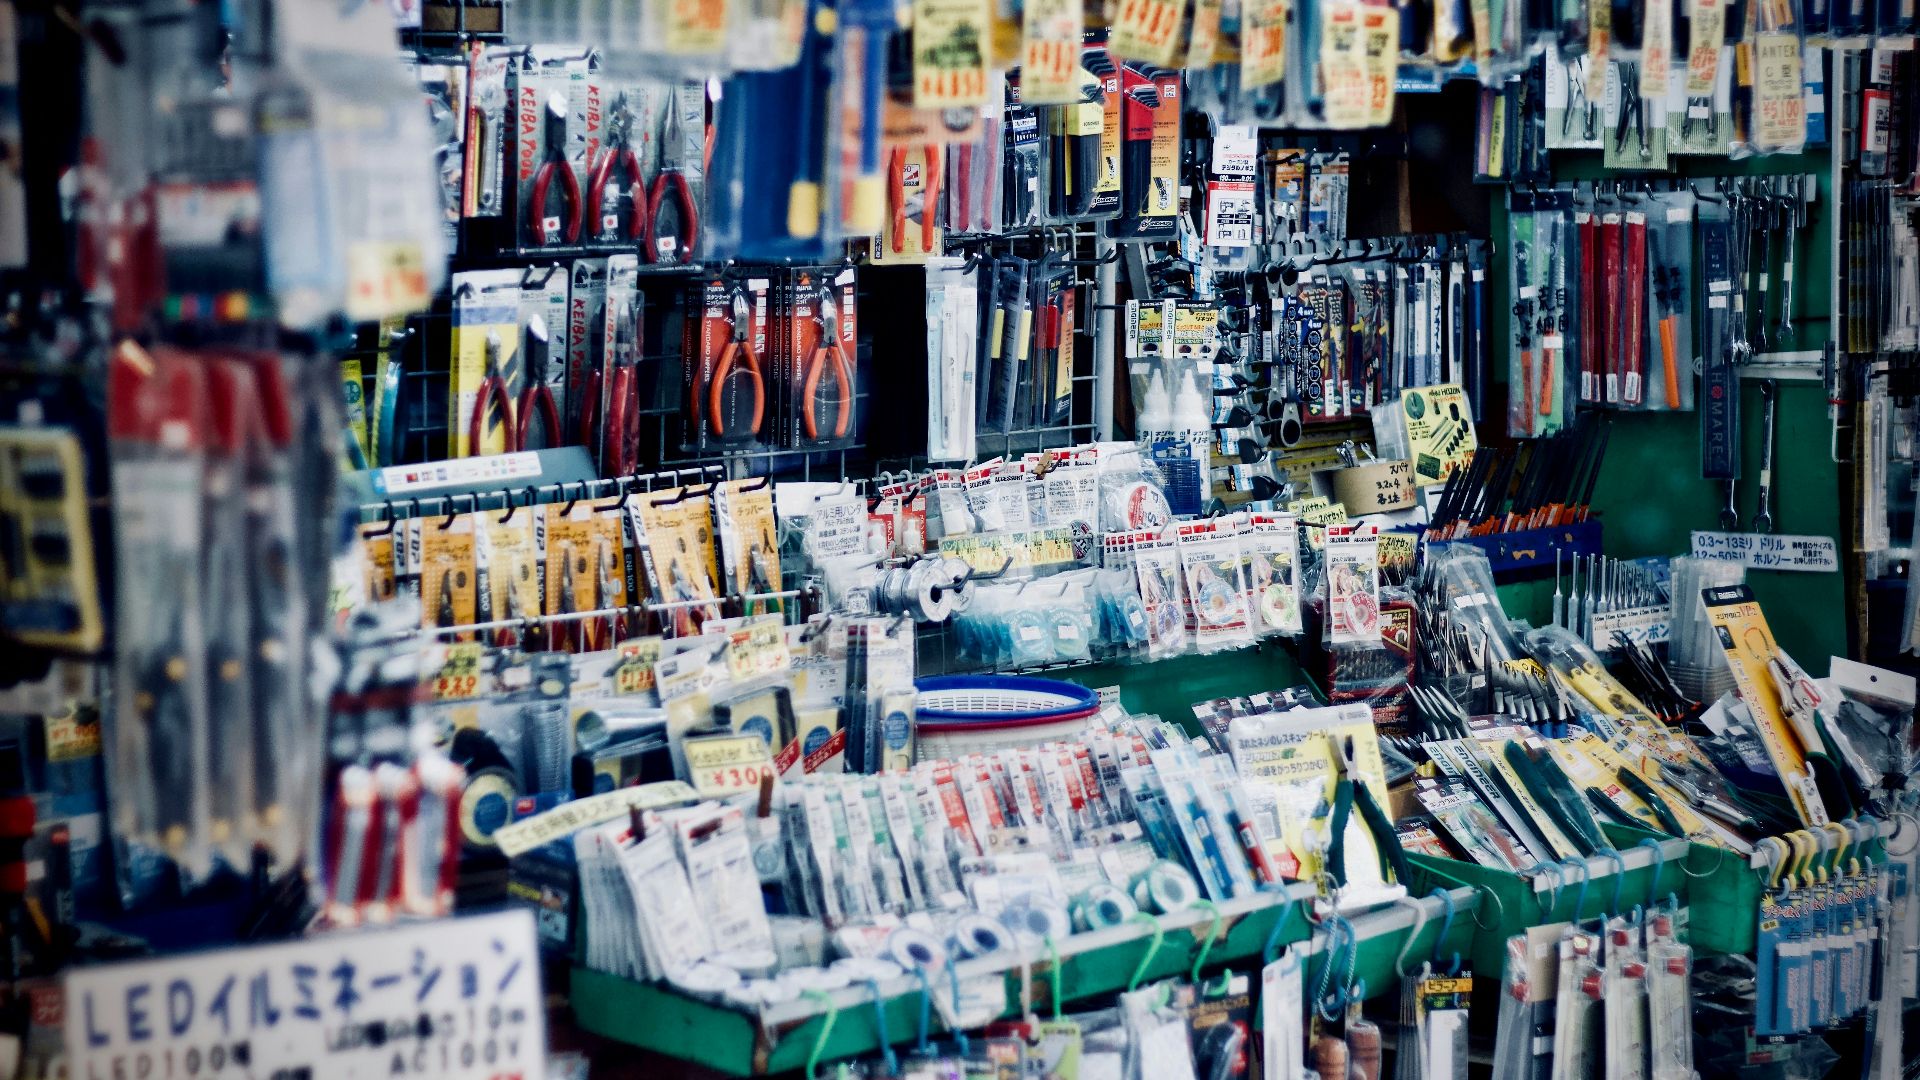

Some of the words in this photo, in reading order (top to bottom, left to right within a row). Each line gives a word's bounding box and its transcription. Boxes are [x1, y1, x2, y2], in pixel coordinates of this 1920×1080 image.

[1761, 44, 1797, 58] ANTEX
[520, 86, 537, 135] KEIBA
[586, 85, 601, 132] KEIBA
[570, 298, 586, 347] KEIBA
[704, 319, 712, 358] STANDARD
[1129, 302, 1137, 344] ENGINEER
[1166, 302, 1174, 341] ENGINEER
[816, 503, 862, 520] アルミ用ハンダ
[410, 526, 420, 564] TOP
[535, 513, 546, 552] TOP
[1759, 537, 1786, 551] ドリル
[1753, 552, 1792, 566] ホルソー
[1453, 745, 1501, 800] ENGINEER
[82, 939, 523, 1048] LEDイルミネーション
